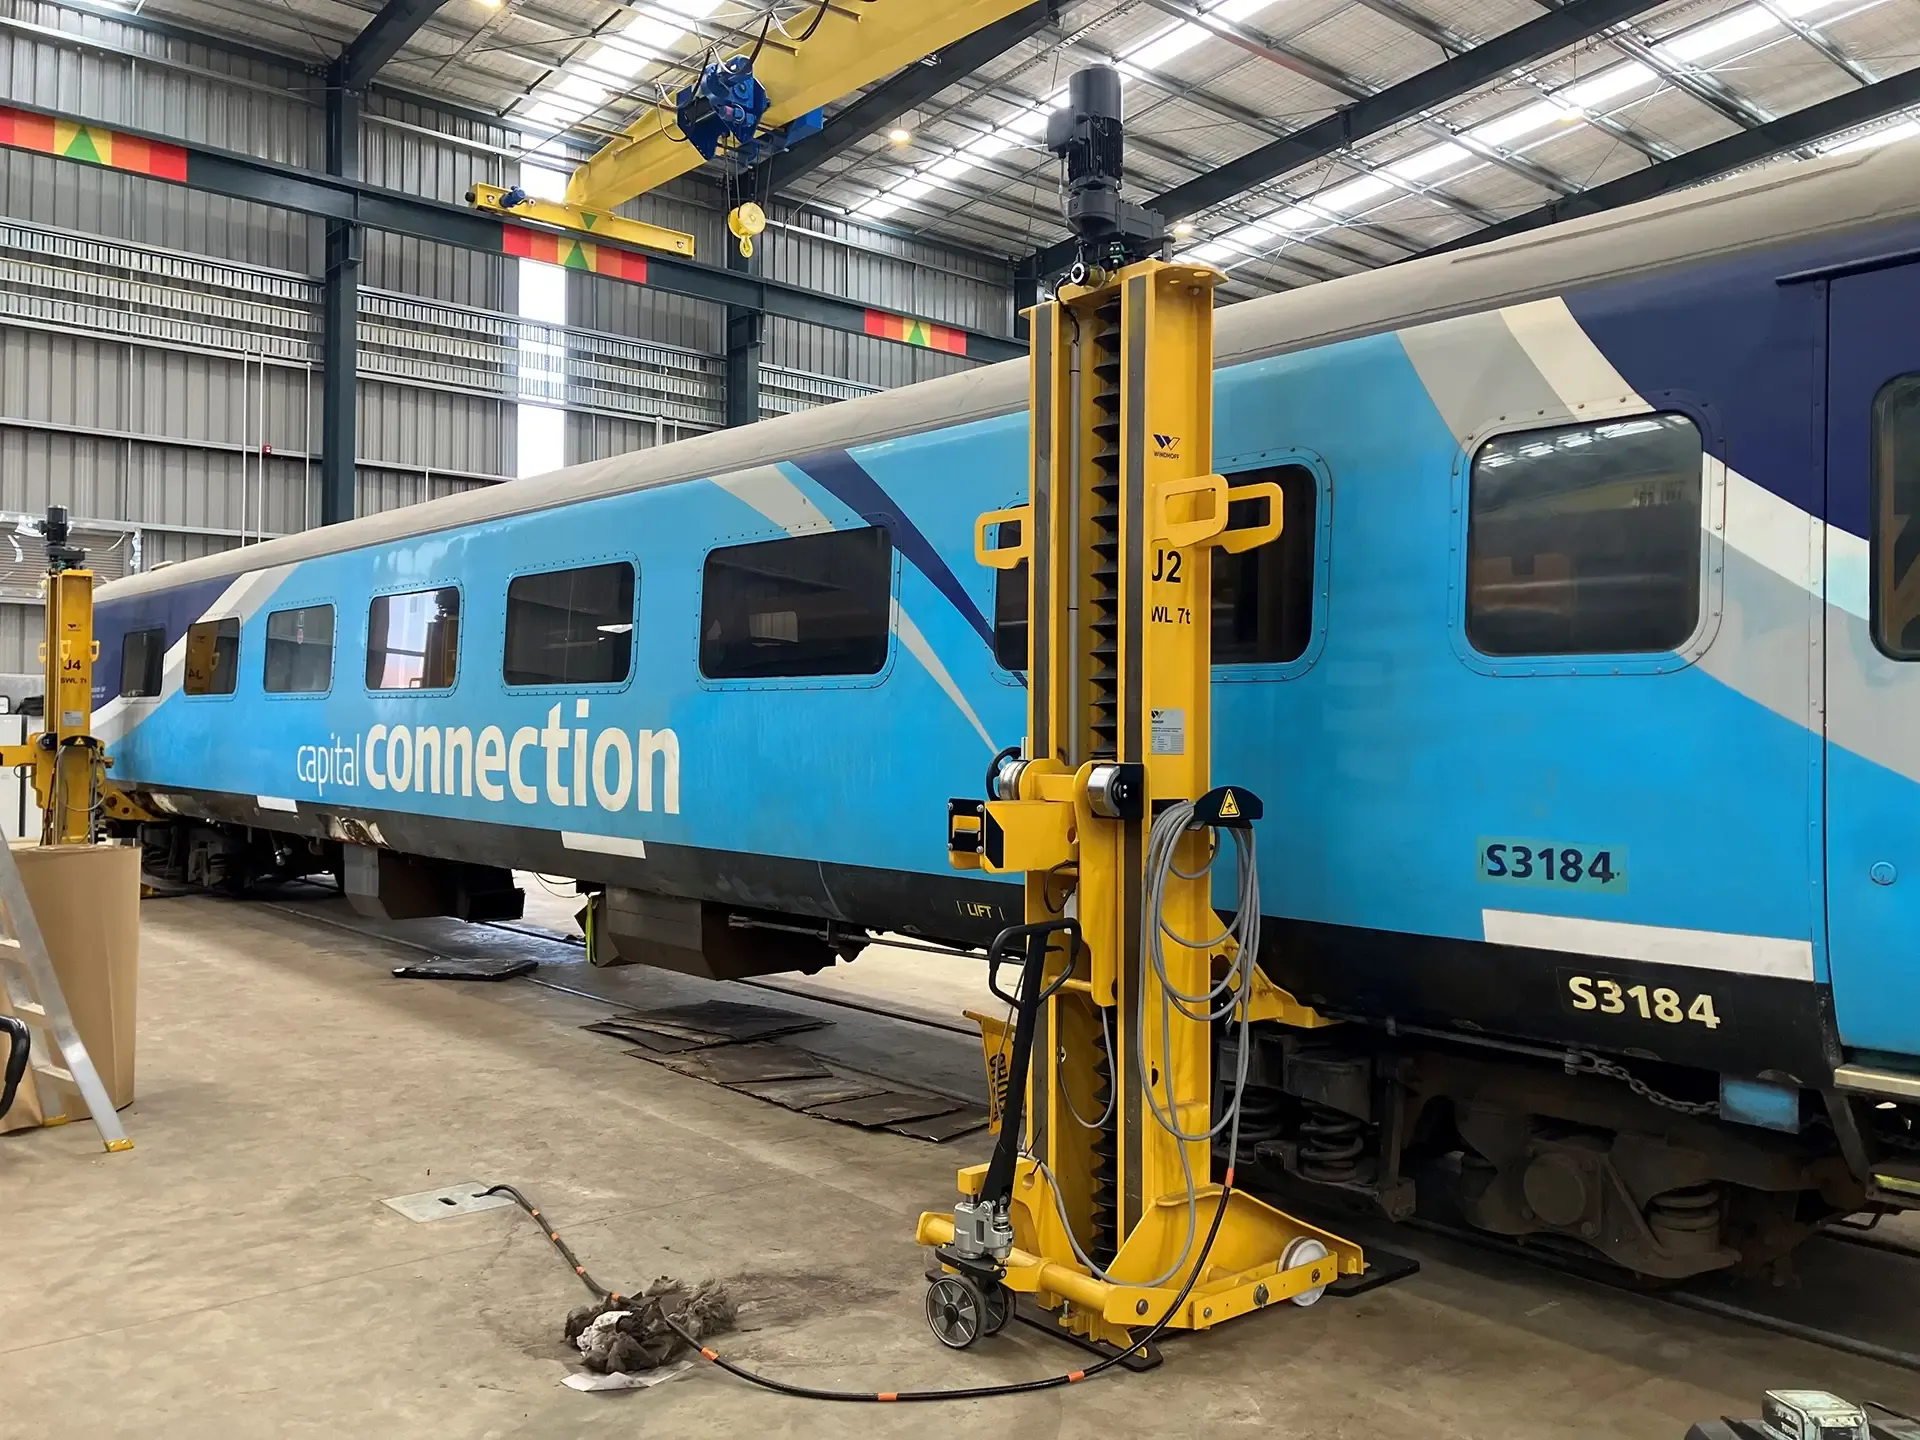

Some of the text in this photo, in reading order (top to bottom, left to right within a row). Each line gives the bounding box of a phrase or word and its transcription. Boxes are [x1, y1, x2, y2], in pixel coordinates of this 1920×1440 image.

[1153, 450, 1180, 460] WINDHOFF
[1152, 549, 1182, 584] J2
[1151, 605, 1191, 625] WL 7t
[63, 659, 82, 671] J4
[296, 698, 681, 815] capital connection
[1486, 843, 1616, 885] S3184
[966, 902, 992, 919] LIFT
[1568, 976, 1721, 1030] S3184
